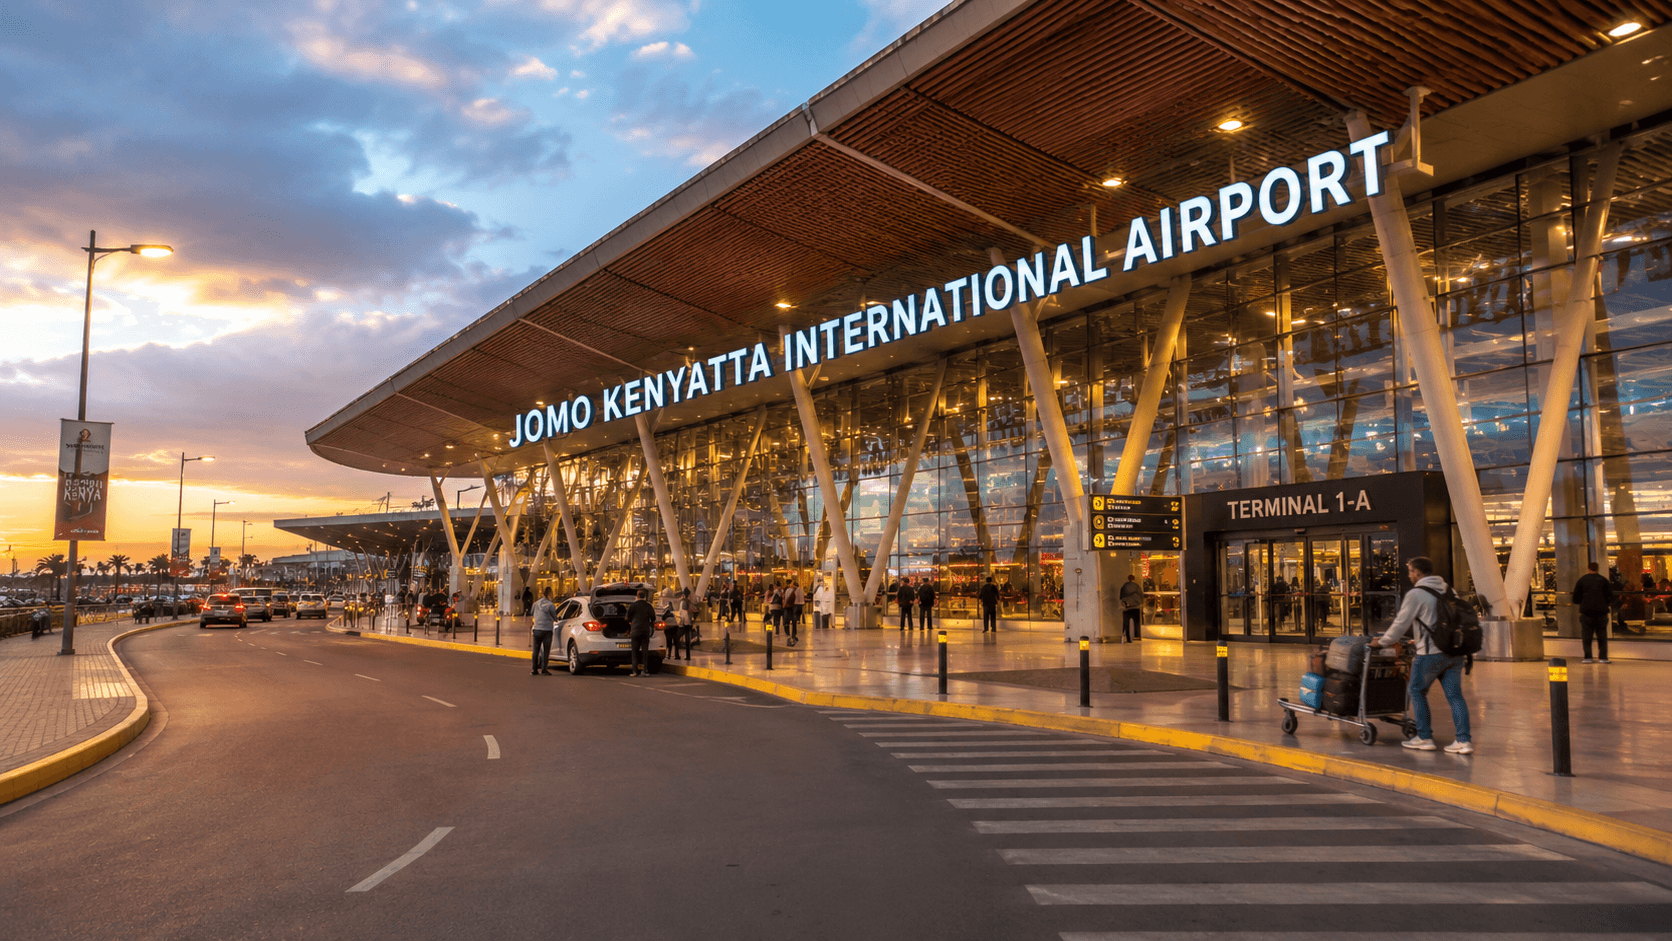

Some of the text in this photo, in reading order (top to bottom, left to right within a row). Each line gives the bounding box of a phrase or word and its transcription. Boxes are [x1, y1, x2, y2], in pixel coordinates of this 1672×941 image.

[509, 130, 1391, 448] JOMO KENYATTA INTERNATIONAL AIRPORT
[1226, 489, 1372, 520] TERMINAL 1-A
